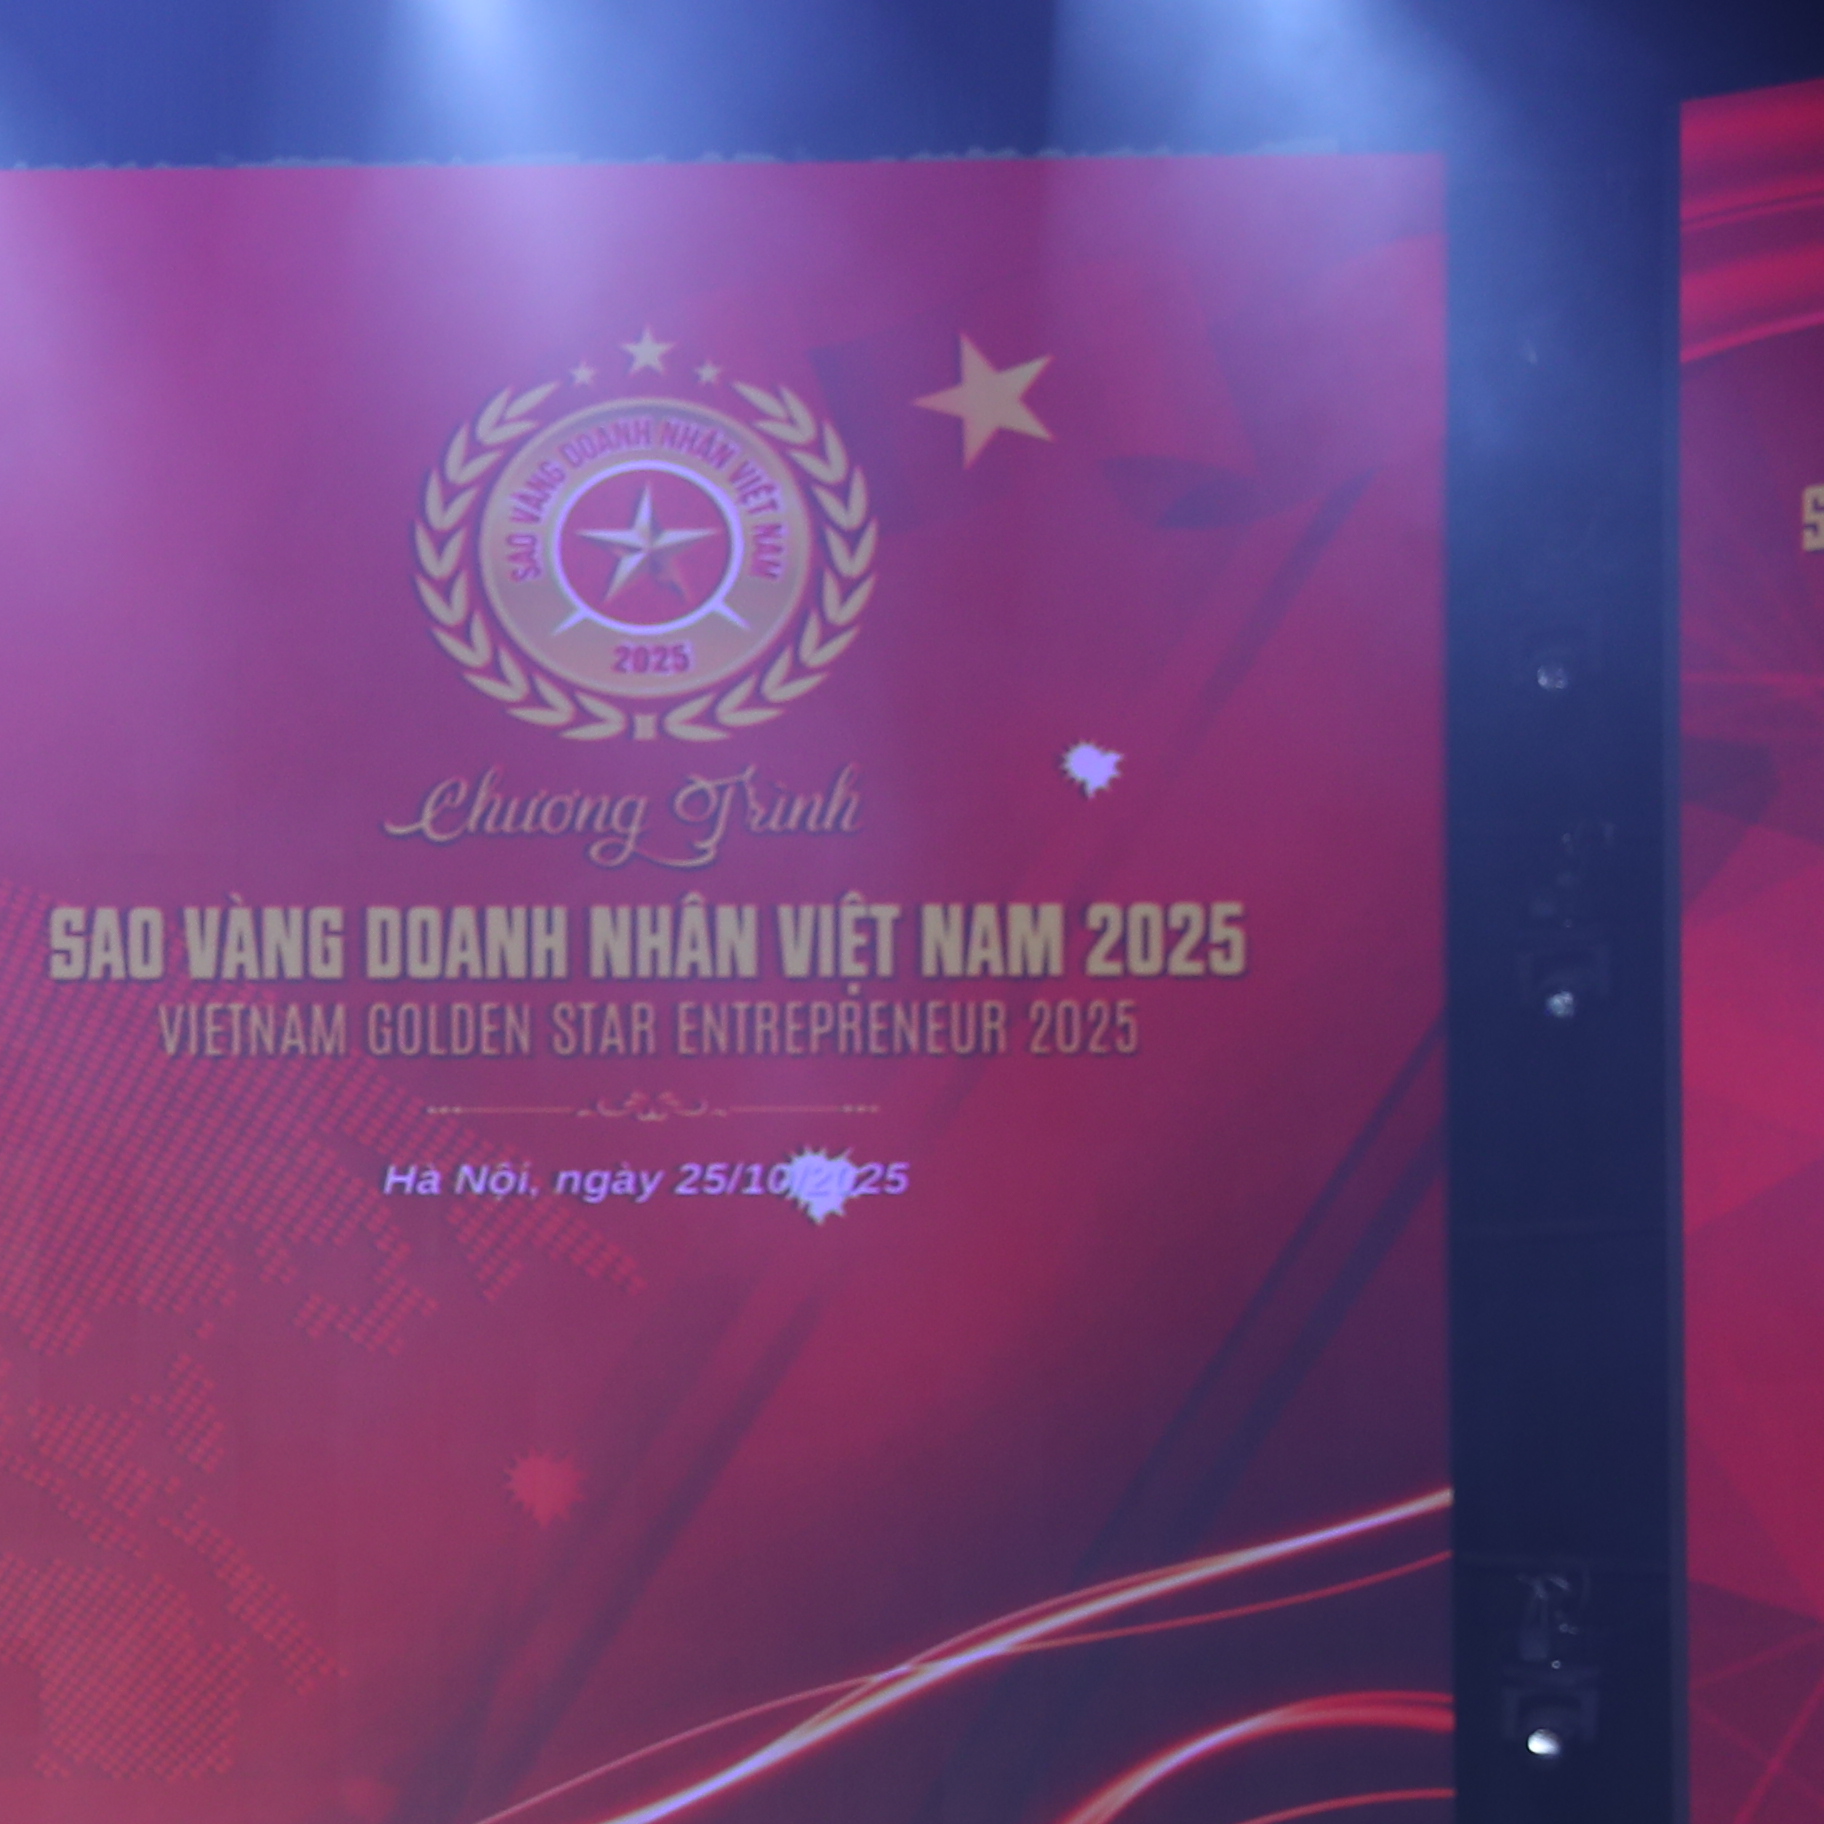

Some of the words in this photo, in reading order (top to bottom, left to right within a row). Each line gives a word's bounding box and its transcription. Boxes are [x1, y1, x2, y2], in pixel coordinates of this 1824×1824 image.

[612, 642, 693, 674] 2025
[383, 764, 648, 868] Chương
[674, 764, 864, 867] Trình
[50, 905, 164, 980] SAO
[184, 892, 344, 981] VÀNG
[366, 905, 568, 980] DOANH
[590, 891, 757, 979] NHÂN
[777, 891, 901, 996] VIỆT
[921, 904, 1064, 977] NAM
[1085, 902, 1246, 977] 2025
[158, 1002, 347, 1057] VIETNAM
[367, 1002, 531, 1057] GOLDEN
[552, 1001, 657, 1056] STAR
[676, 1000, 1008, 1056] ENTREPRENEUR
[1028, 999, 1140, 1055] 2025
[383, 1162, 441, 1197] Hà
[454, 1160, 540, 1202] Nội,
[554, 1162, 665, 1204] ngày
